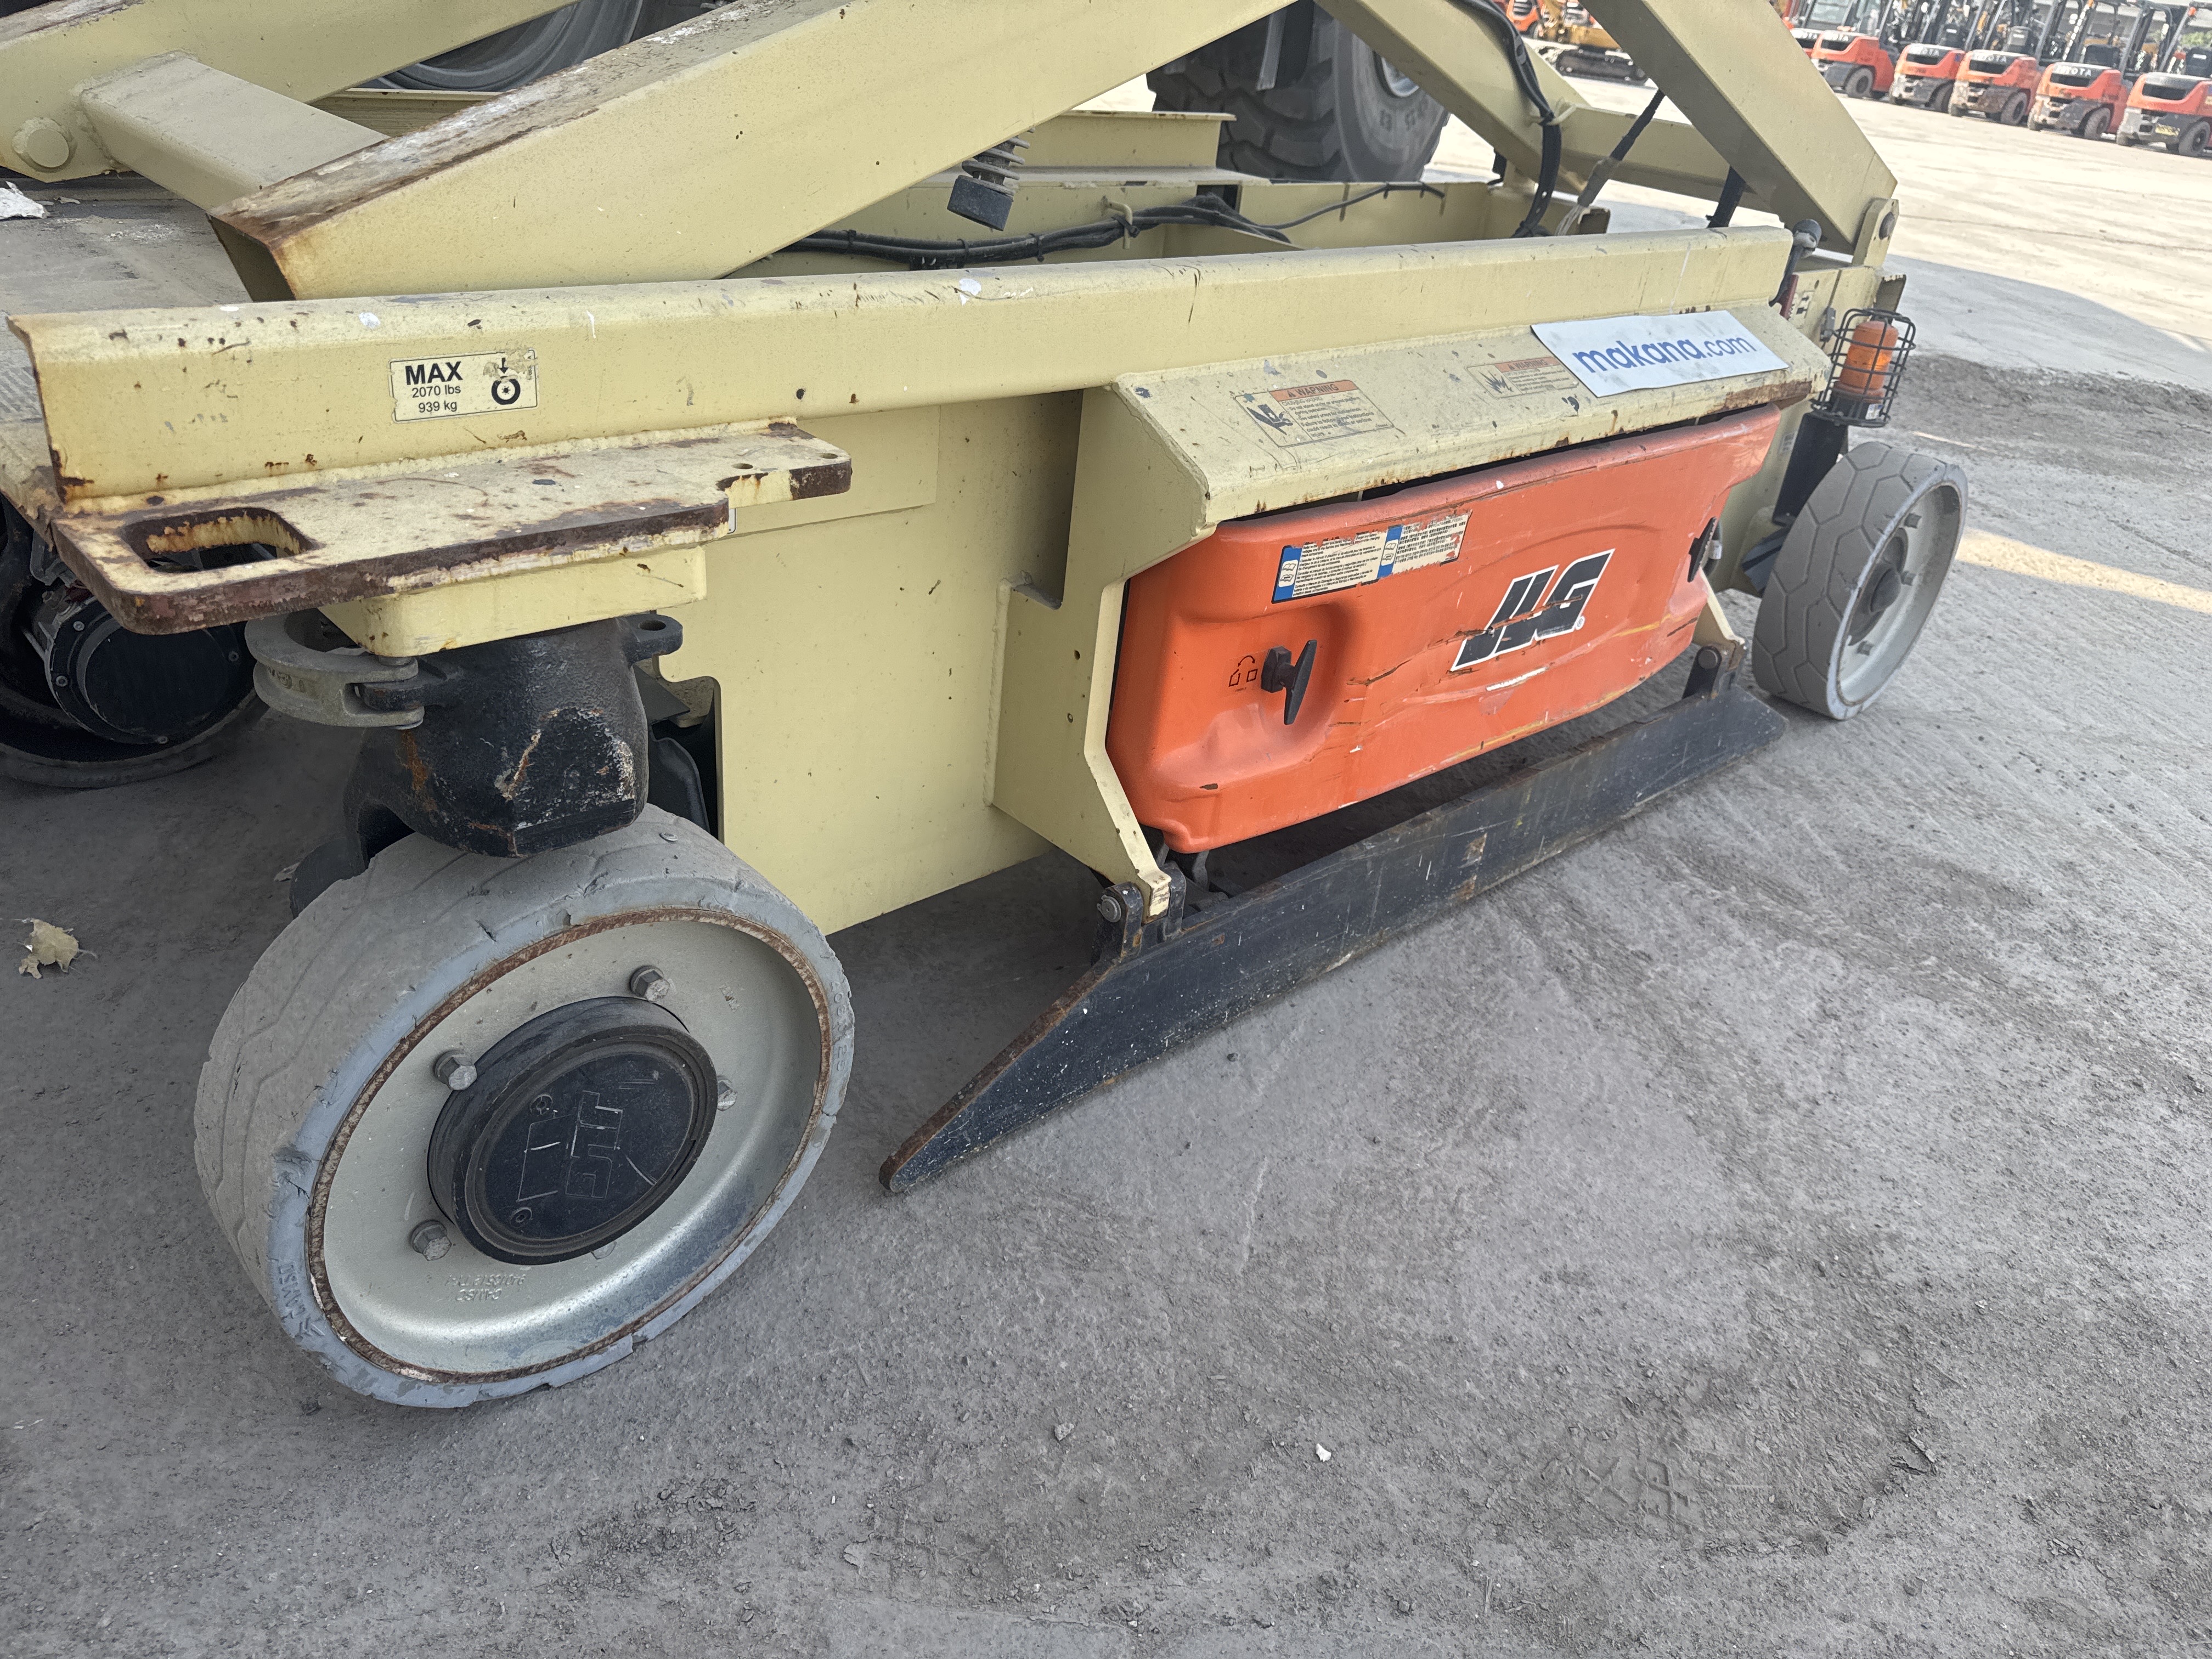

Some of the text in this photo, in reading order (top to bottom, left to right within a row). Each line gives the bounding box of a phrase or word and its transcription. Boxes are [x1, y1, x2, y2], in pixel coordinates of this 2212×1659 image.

[1572, 337, 1757, 374] makana.com
[1514, 359, 1548, 369] WARNING
[405, 361, 463, 385] MAX
[412, 384, 461, 398] 2070 lbs
[1296, 384, 1339, 396] WARNING
[419, 400, 457, 413] 939 kg
[1451, 548, 1616, 671] JLG
